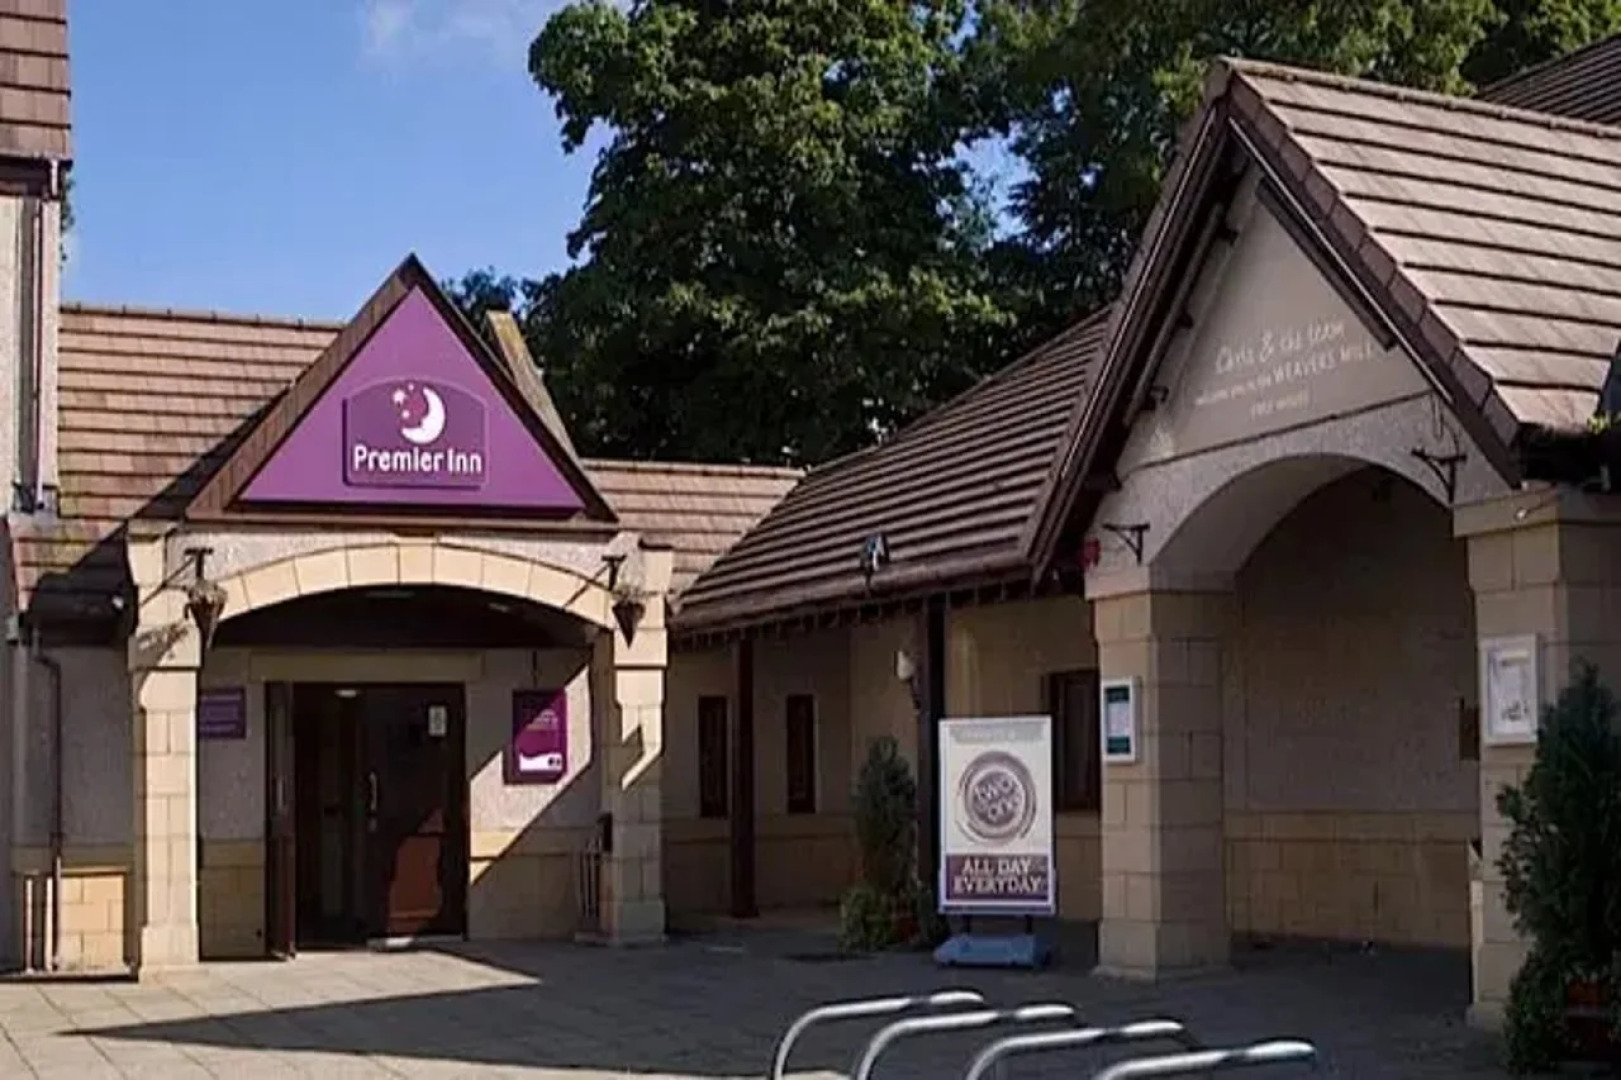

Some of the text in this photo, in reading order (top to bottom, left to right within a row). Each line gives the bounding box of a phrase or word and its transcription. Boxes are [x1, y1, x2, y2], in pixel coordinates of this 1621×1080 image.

[354, 444, 482, 473] Premier Inn
[962, 857, 1031, 876] ALL DAY
[953, 875, 1042, 895] EVERYDAY
